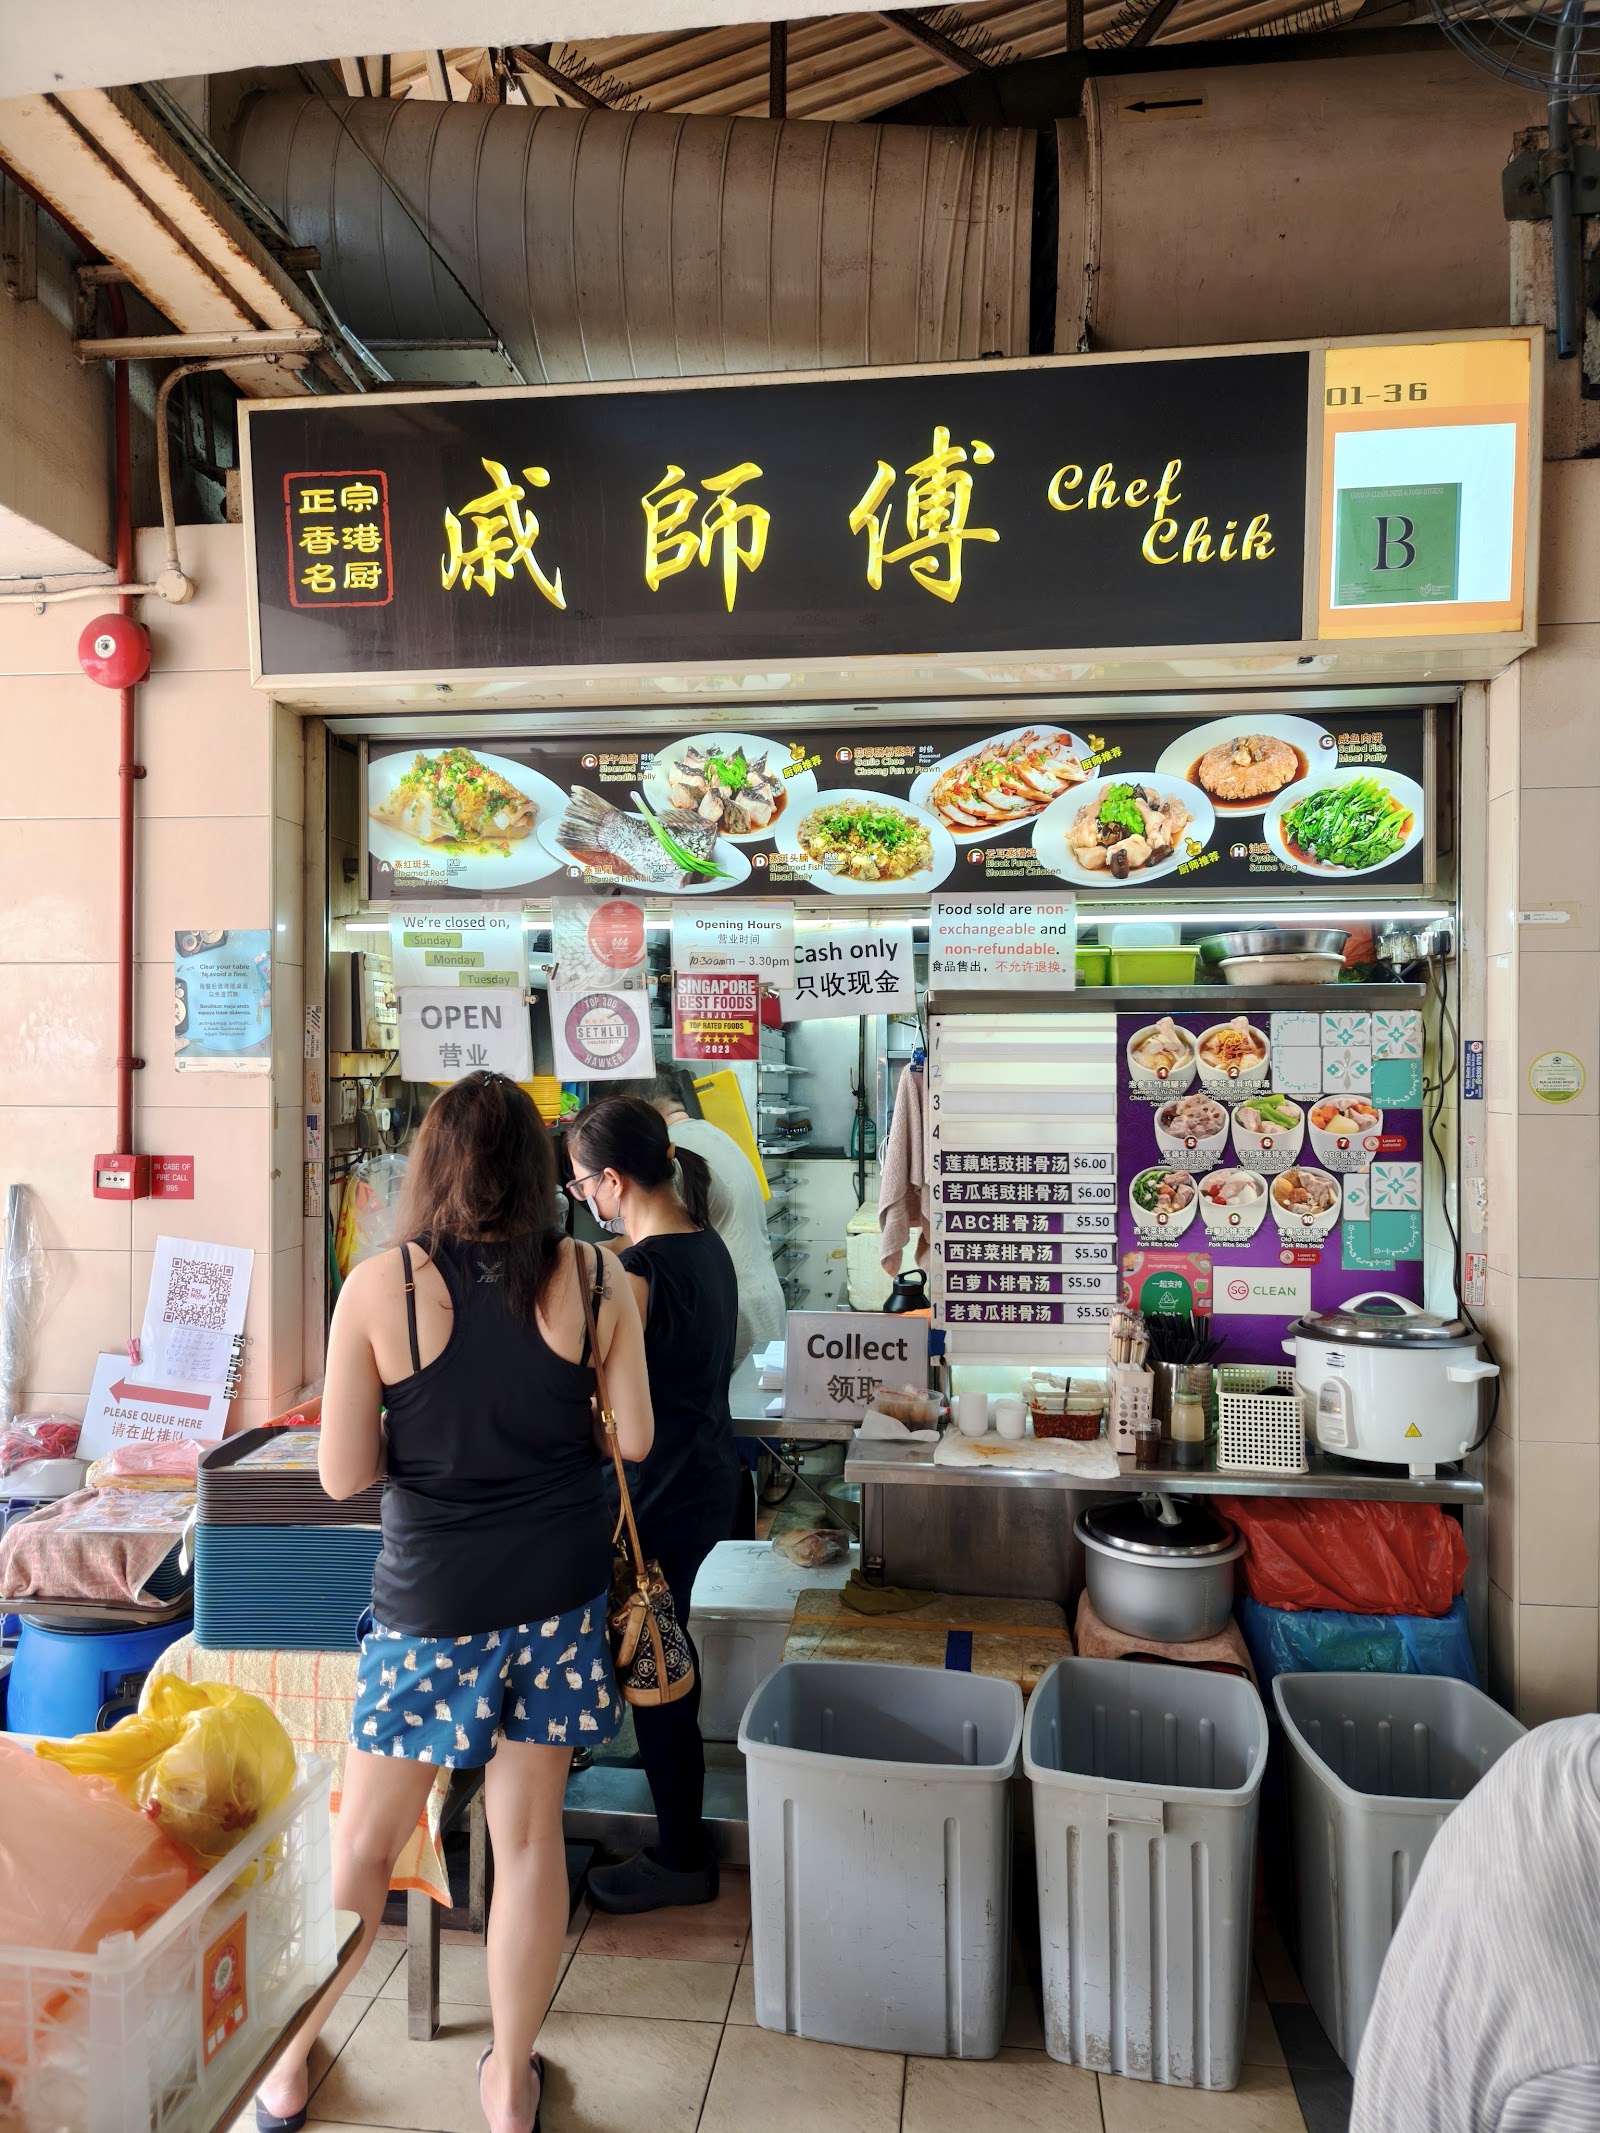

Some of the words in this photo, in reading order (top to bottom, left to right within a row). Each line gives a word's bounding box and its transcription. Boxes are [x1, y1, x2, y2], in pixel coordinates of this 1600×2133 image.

[1325, 383, 1427, 406] 01-36
[1048, 459, 1182, 521] Chef
[299, 481, 379, 514] 正宗
[299, 523, 383, 555] 香港
[1142, 514, 1275, 565] Chik
[1370, 515, 1417, 572] B
[300, 561, 382, 593] 名厨
[1322, 736, 1333, 748] G
[1338, 732, 1383, 744] 咸鱼肉饼
[1338, 744, 1367, 753] Salted
[1368, 744, 1387, 752] Fish
[585, 757, 595, 767] C
[840, 750, 849, 761] E
[1080, 746, 1122, 771] 厨师推荐
[1338, 754, 1363, 762] Meat
[1364, 753, 1388, 763] Patty
[783, 754, 822, 779] 厨师推荐
[915, 766, 941, 774] Prawn
[972, 852, 981, 863] F
[1233, 847, 1244, 857] H
[756, 857, 765, 867] D
[1178, 850, 1220, 875] 厨师推荐
[1249, 854, 1278, 864] Oyster
[380, 862, 390, 872] A
[570, 867, 579, 878] B
[769, 864, 805, 872] Steamed
[1025, 868, 1061, 876] Chicken
[1249, 863, 1278, 872] Sauce
[1279, 863, 1298, 873] Veg
[938, 903, 972, 915] Food
[976, 903, 1005, 915] sold
[1009, 905, 1032, 915] are
[1036, 905, 1069, 915] non-
[402, 916, 441, 928] We're
[444, 915, 486, 929] closed
[489, 917, 511, 930] on,
[695, 919, 745, 931] Opening
[747, 919, 782, 930] Hours
[939, 923, 1036, 937] exchangeable
[1040, 923, 1067, 935] and
[414, 935, 452, 948] Sunday
[717, 934, 760, 945] 营业时间
[850, 938, 899, 961] only
[944, 942, 1060, 955] non-refundable.
[433, 954, 476, 967] Monday
[748, 956, 790, 968] 3.30pm
[467, 974, 511, 987] Tuesday
[678, 979, 756, 994] SINGAPORE
[795, 969, 900, 1001] 只收现金
[584, 996, 600, 1008] TOP
[602, 996, 618, 1008] 300
[680, 996, 709, 1009] BEST
[713, 996, 753, 1009] FOODS
[420, 1005, 502, 1029] OPEN
[578, 1026, 627, 1038] SETHLUI
[702, 1022, 722, 1030] RATED
[723, 1022, 744, 1030] FOODS
[439, 1043, 490, 1068] 营业
[705, 1045, 730, 1054] 2023
[584, 1053, 625, 1068] HAWKER
[933, 1094, 940, 1110] 3
[932, 1124, 940, 1139] 4
[1340, 1139, 1346, 1147] 7
[181, 1163, 191, 1171] OF
[945, 1155, 1067, 1173] 莲藕蚝豉排骨汤
[1073, 1157, 1107, 1170] $6.00
[947, 1183, 1069, 1201] 苦瓜蚝豉排骨汤
[1077, 1187, 1111, 1199] $6.00
[950, 1214, 1049, 1232] ABC排骨汤
[1076, 1216, 1110, 1228] $5.50
[1160, 1214, 1166, 1223] 8
[1231, 1214, 1238, 1223] 9
[1302, 1215, 1313, 1224] 10
[949, 1243, 1053, 1262] 西洋菜排骨汤
[1075, 1248, 1108, 1259] $5.50
[950, 1274, 1050, 1292] 白萝卜排骨汤
[1068, 1276, 1101, 1289] $5.50
[1152, 1280, 1183, 1289] 一起支持
[1231, 1286, 1246, 1295] SG
[1253, 1287, 1297, 1296] CLEAN
[950, 1304, 1052, 1322] 老黄瓜排骨汤
[806, 1331, 908, 1362] Collect
[827, 1373, 884, 1405] 领取
[104, 1406, 139, 1420] PLEASE
[140, 1412, 175, 1426] QUEUE
[177, 1417, 203, 1429] HERE
